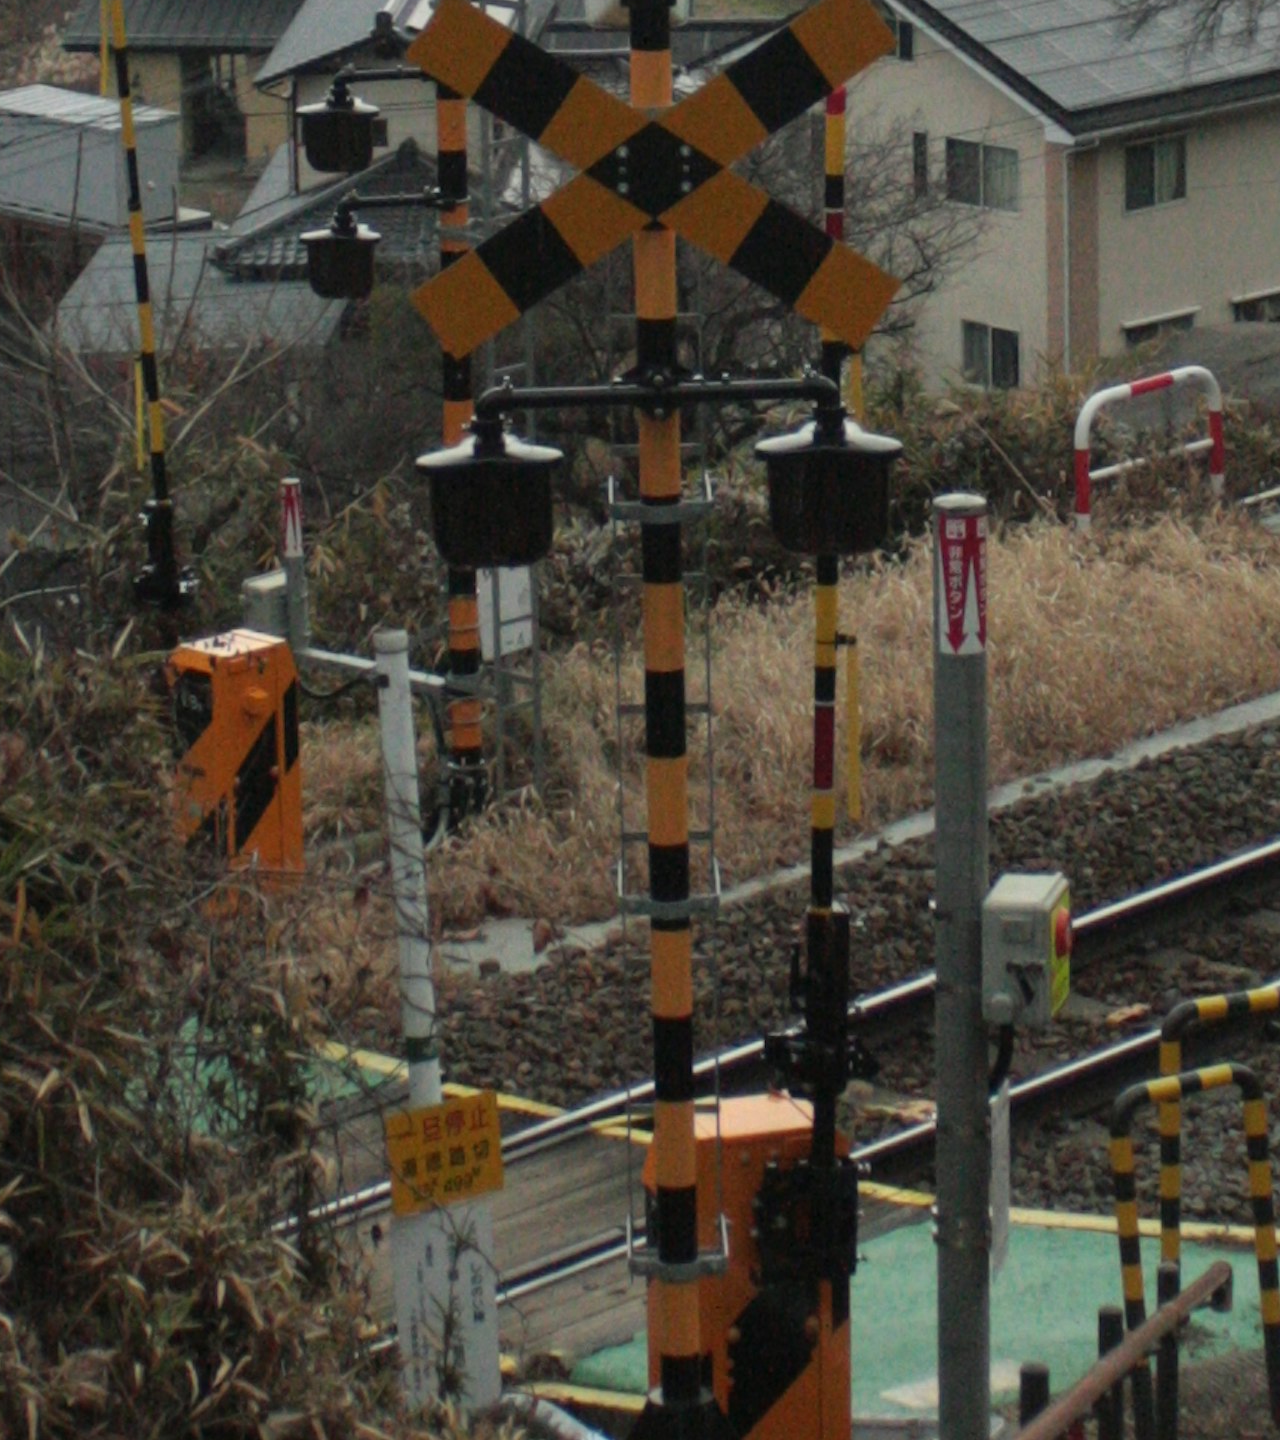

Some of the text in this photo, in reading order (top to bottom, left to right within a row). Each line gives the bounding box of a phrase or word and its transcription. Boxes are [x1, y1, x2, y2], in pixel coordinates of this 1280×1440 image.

[948, 545, 964, 619] 非常ボタン
